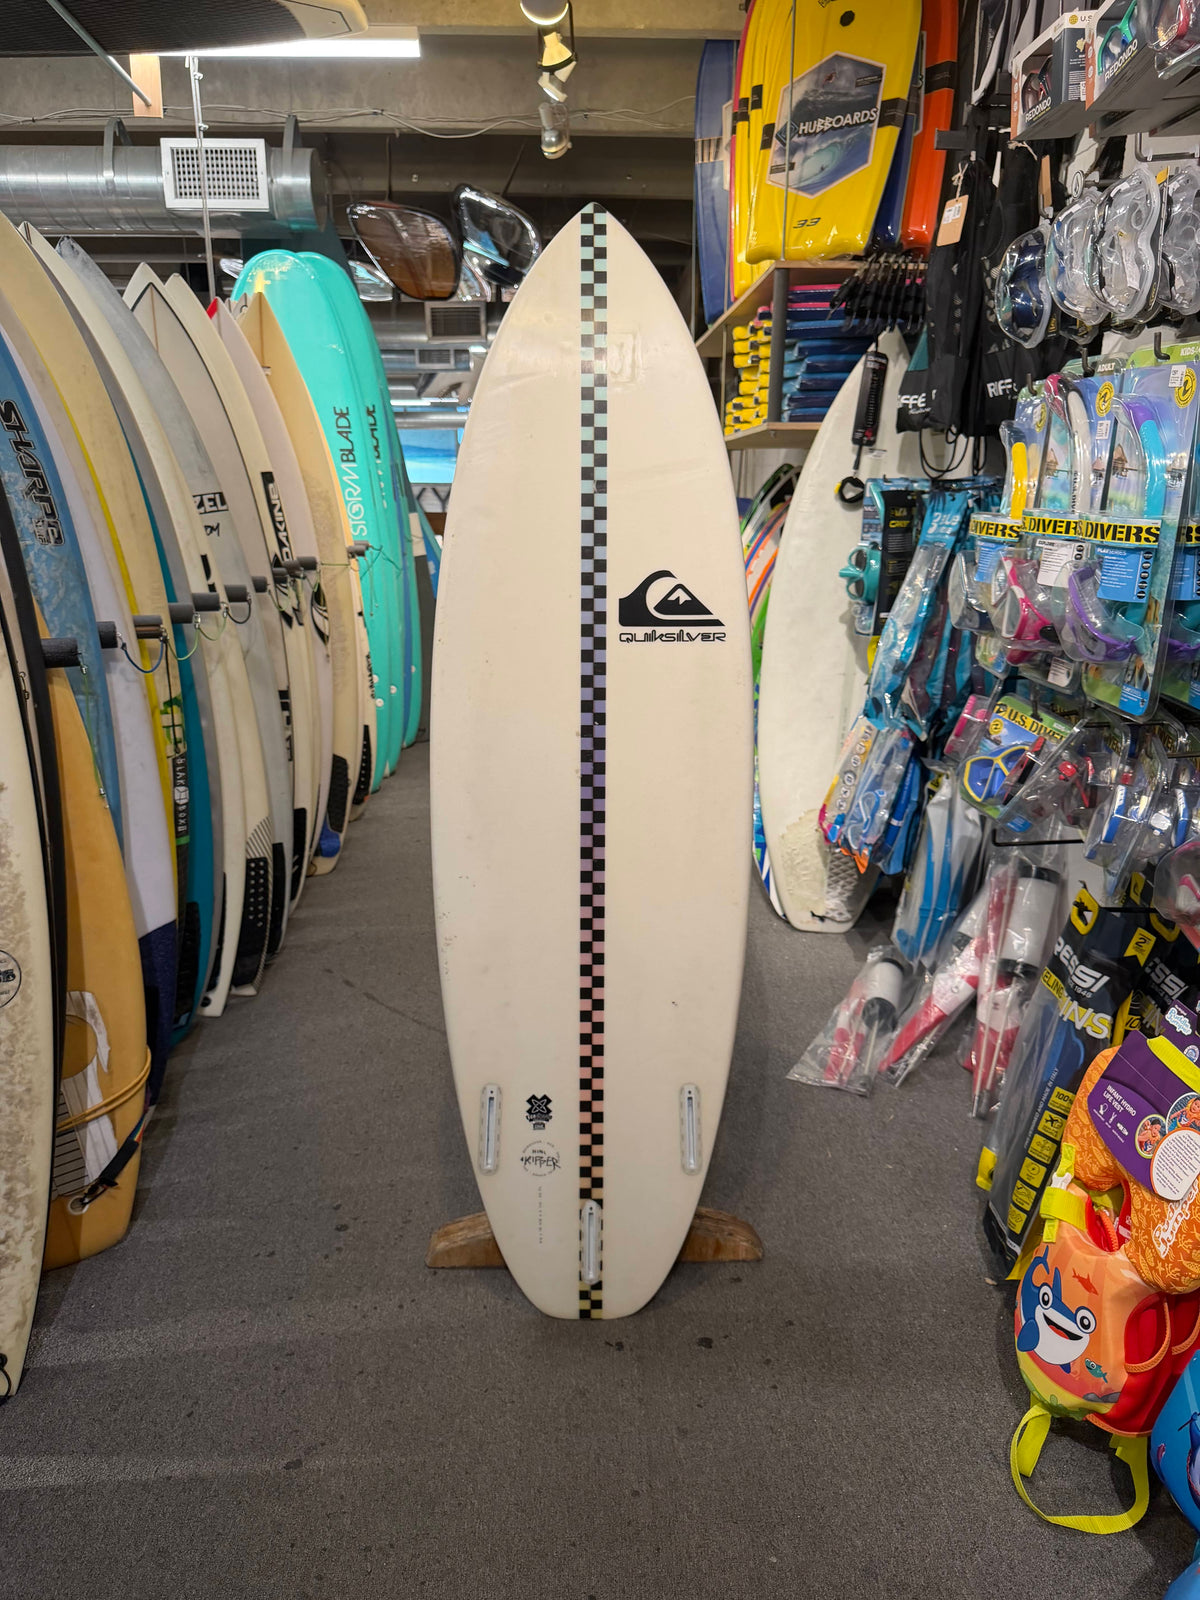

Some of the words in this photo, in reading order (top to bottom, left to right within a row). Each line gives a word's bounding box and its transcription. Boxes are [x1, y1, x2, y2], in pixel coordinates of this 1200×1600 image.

[1105, 39, 1138, 82] REDONDO
[1025, 96, 1052, 123] REDONDO
[798, 107, 879, 135] HUBBOARDS
[792, 217, 821, 229] 33
[1097, 362, 1116, 373] ADULT
[192, 492, 229, 514] ZEL
[268, 483, 294, 562] DAKINE
[1028, 518, 1078, 536] DIVER
[1084, 521, 1160, 543] DIVERS
[619, 629, 727, 643] QUIKSILVER
[1008, 706, 1028, 728] U.S.
[1054, 935, 1111, 993] RESSI
[1042, 969, 1065, 999] ELING
[1059, 996, 1114, 1039] INS
[1169, 1009, 1190, 1028] Puddle
[1050, 1067, 1059, 1082] ITALY
[1103, 1090, 1114, 1103] LIFE
[1112, 1100, 1124, 1113] VEST
[1106, 1085, 1123, 1103] INFANT
[1120, 1099, 1137, 1117] HYDRO
[523, 1155, 561, 1171] KIPPER
